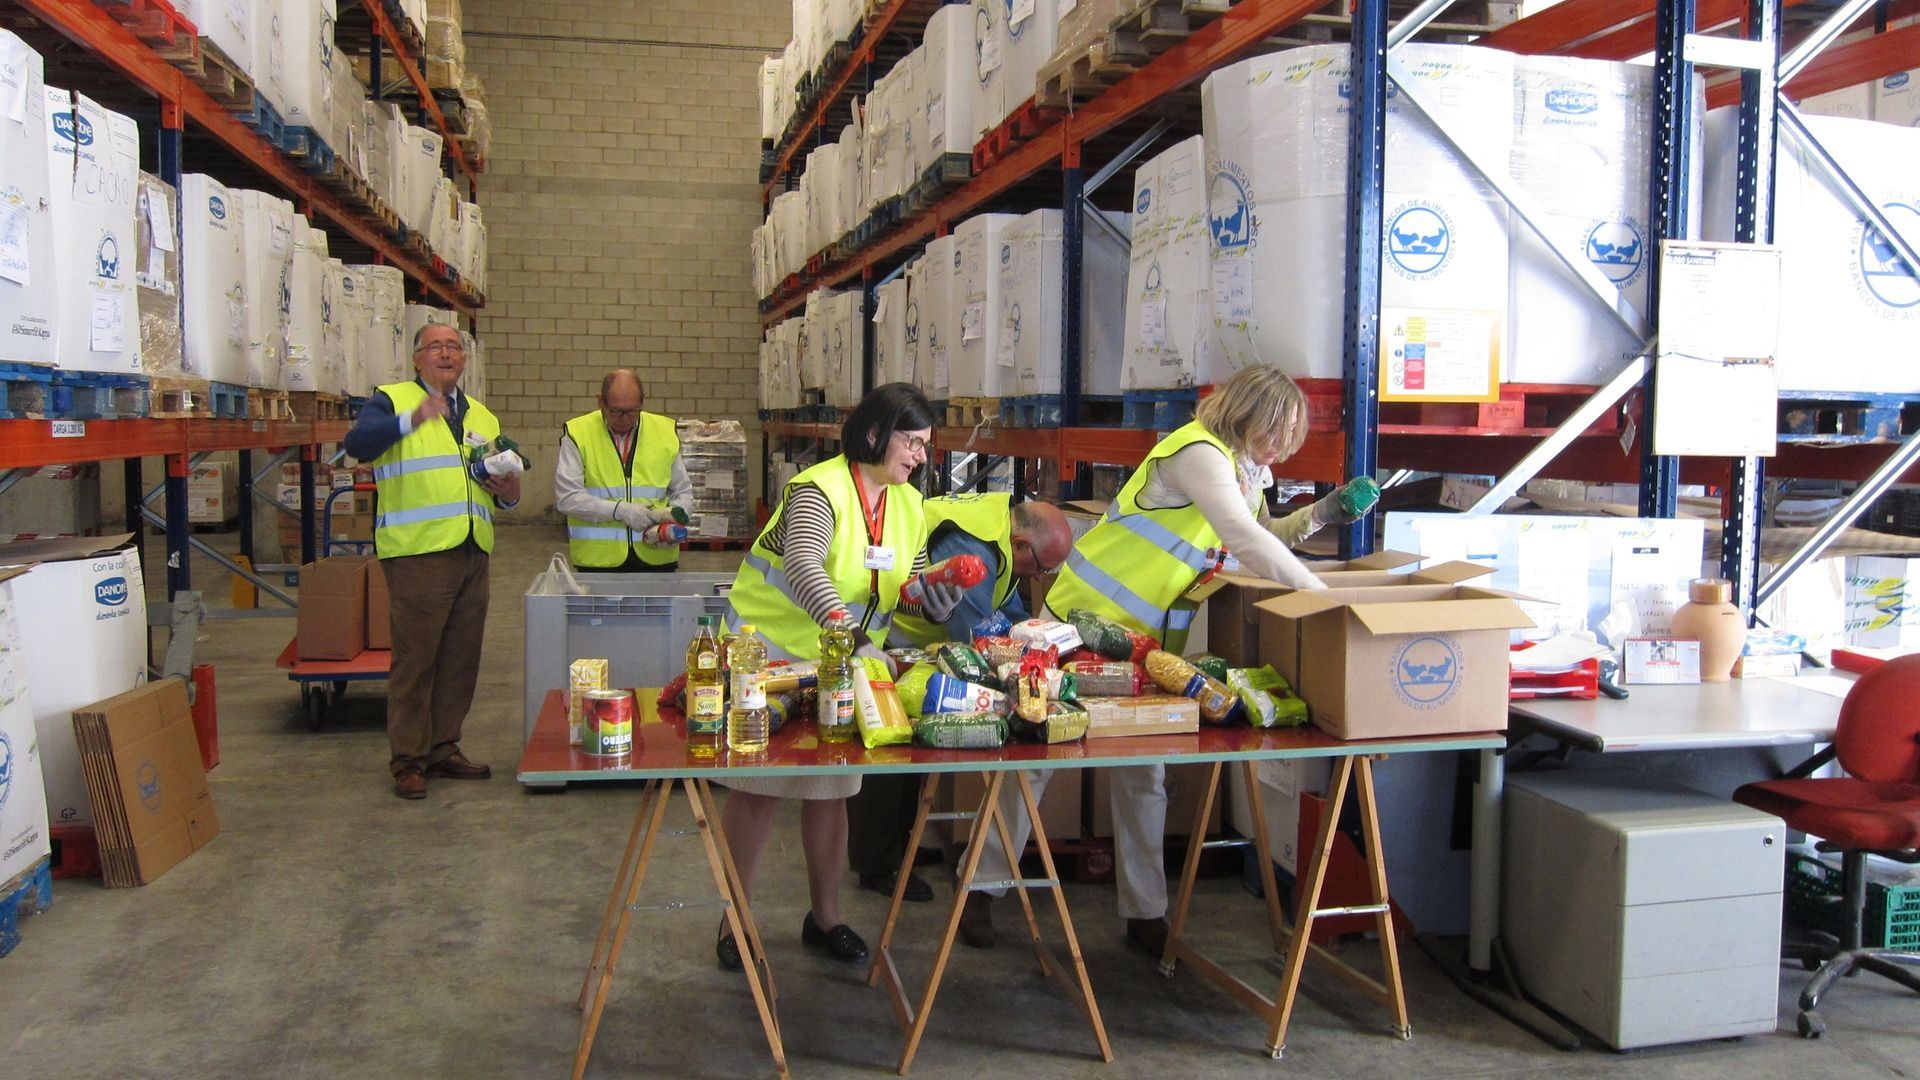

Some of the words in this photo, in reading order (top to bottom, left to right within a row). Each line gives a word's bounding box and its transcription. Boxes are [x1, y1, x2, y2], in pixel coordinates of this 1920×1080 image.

[1383, 203, 1407, 236] BANCOS
[1407, 199, 1420, 208] DE
[1421, 199, 1457, 237] ALIMENTOS
[1383, 244, 1405, 278] BANCOS
[1406, 273, 1418, 282] DE
[1420, 248, 1457, 281] ALIMENTOS
[93, 562, 107, 573] Con
